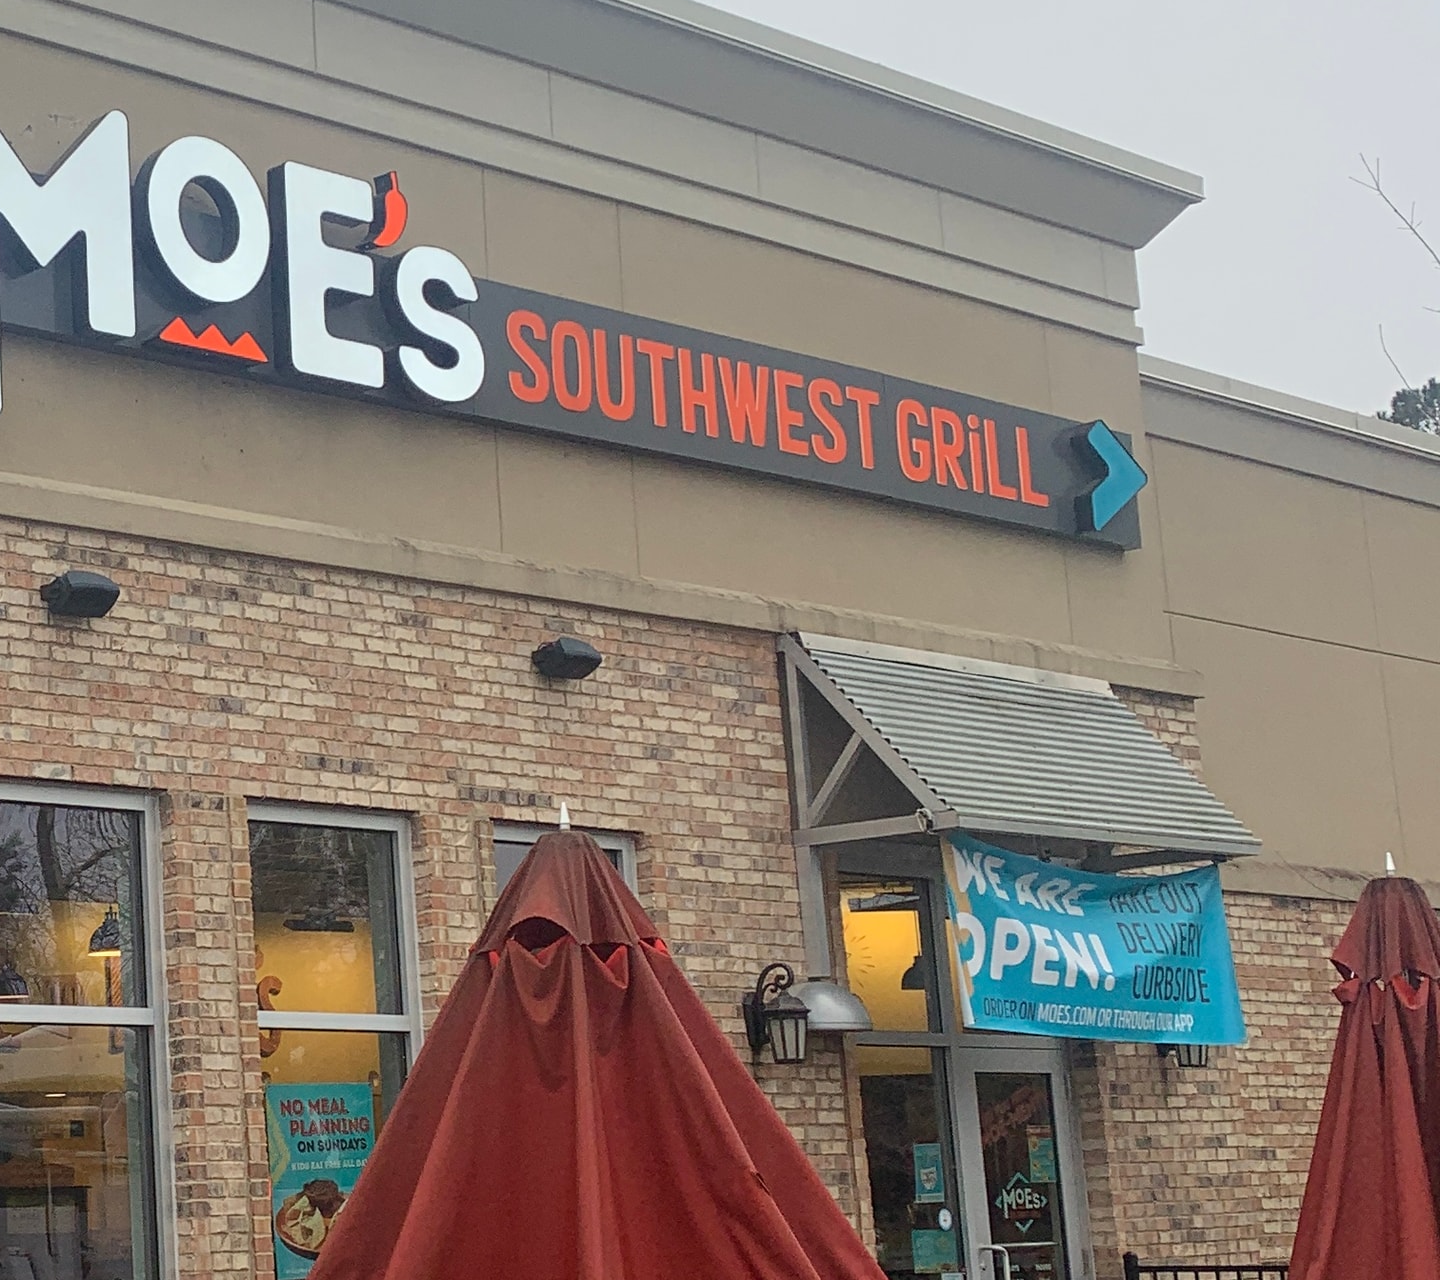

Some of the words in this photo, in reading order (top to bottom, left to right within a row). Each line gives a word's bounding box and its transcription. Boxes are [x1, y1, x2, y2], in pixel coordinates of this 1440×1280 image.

[505, 308, 881, 470] SOUTHWEST
[952, 846, 1009, 902] WE
[1014, 871, 1098, 917] ARE
[1158, 881, 1202, 915] OUT
[956, 912, 1116, 992] OPEN!
[1116, 921, 1203, 958] DELIVERY
[1132, 964, 1211, 1003] CURBSIDE
[983, 997, 1017, 1019] ORDER
[1019, 1004, 1036, 1021] ON
[1037, 1002, 1097, 1026] MOES.COM
[1098, 1009, 1113, 1028] OR
[1113, 1010, 1155, 1031] THROUGH
[1174, 1013, 1194, 1033] APP
[279, 1099, 304, 1117] NO
[308, 1098, 349, 1116] MEAL
[289, 1116, 370, 1137] PLANNING
[297, 1139, 315, 1153] ON
[317, 1138, 368, 1152] SUNDAYS
